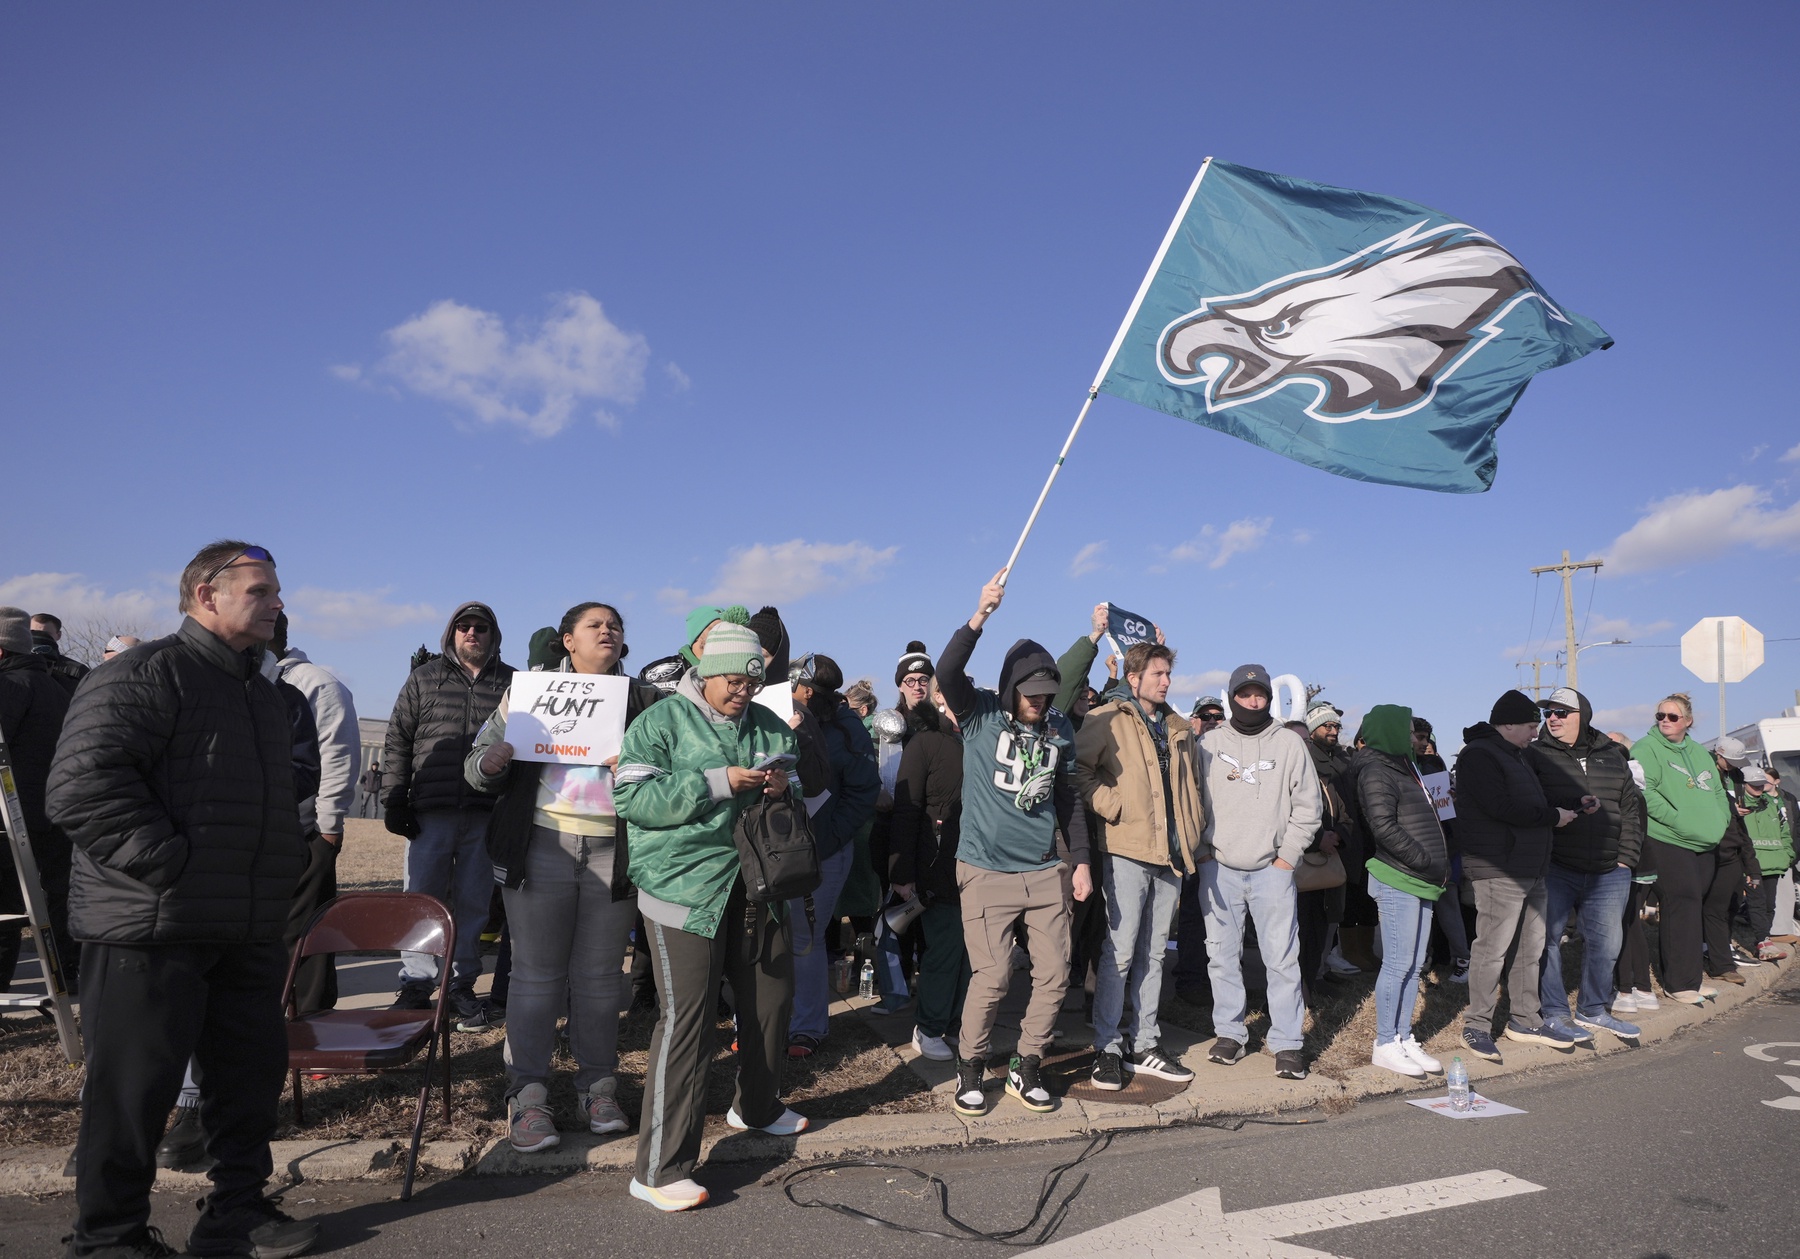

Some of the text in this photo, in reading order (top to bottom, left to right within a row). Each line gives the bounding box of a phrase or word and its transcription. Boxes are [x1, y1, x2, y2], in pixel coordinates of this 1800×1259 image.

[1124, 619, 1147, 637] GO
[1117, 634, 1156, 646] BIR
[546, 680, 595, 695] LET'S
[529, 695, 605, 718] HUNT
[534, 743, 591, 757] DUNKIN'
